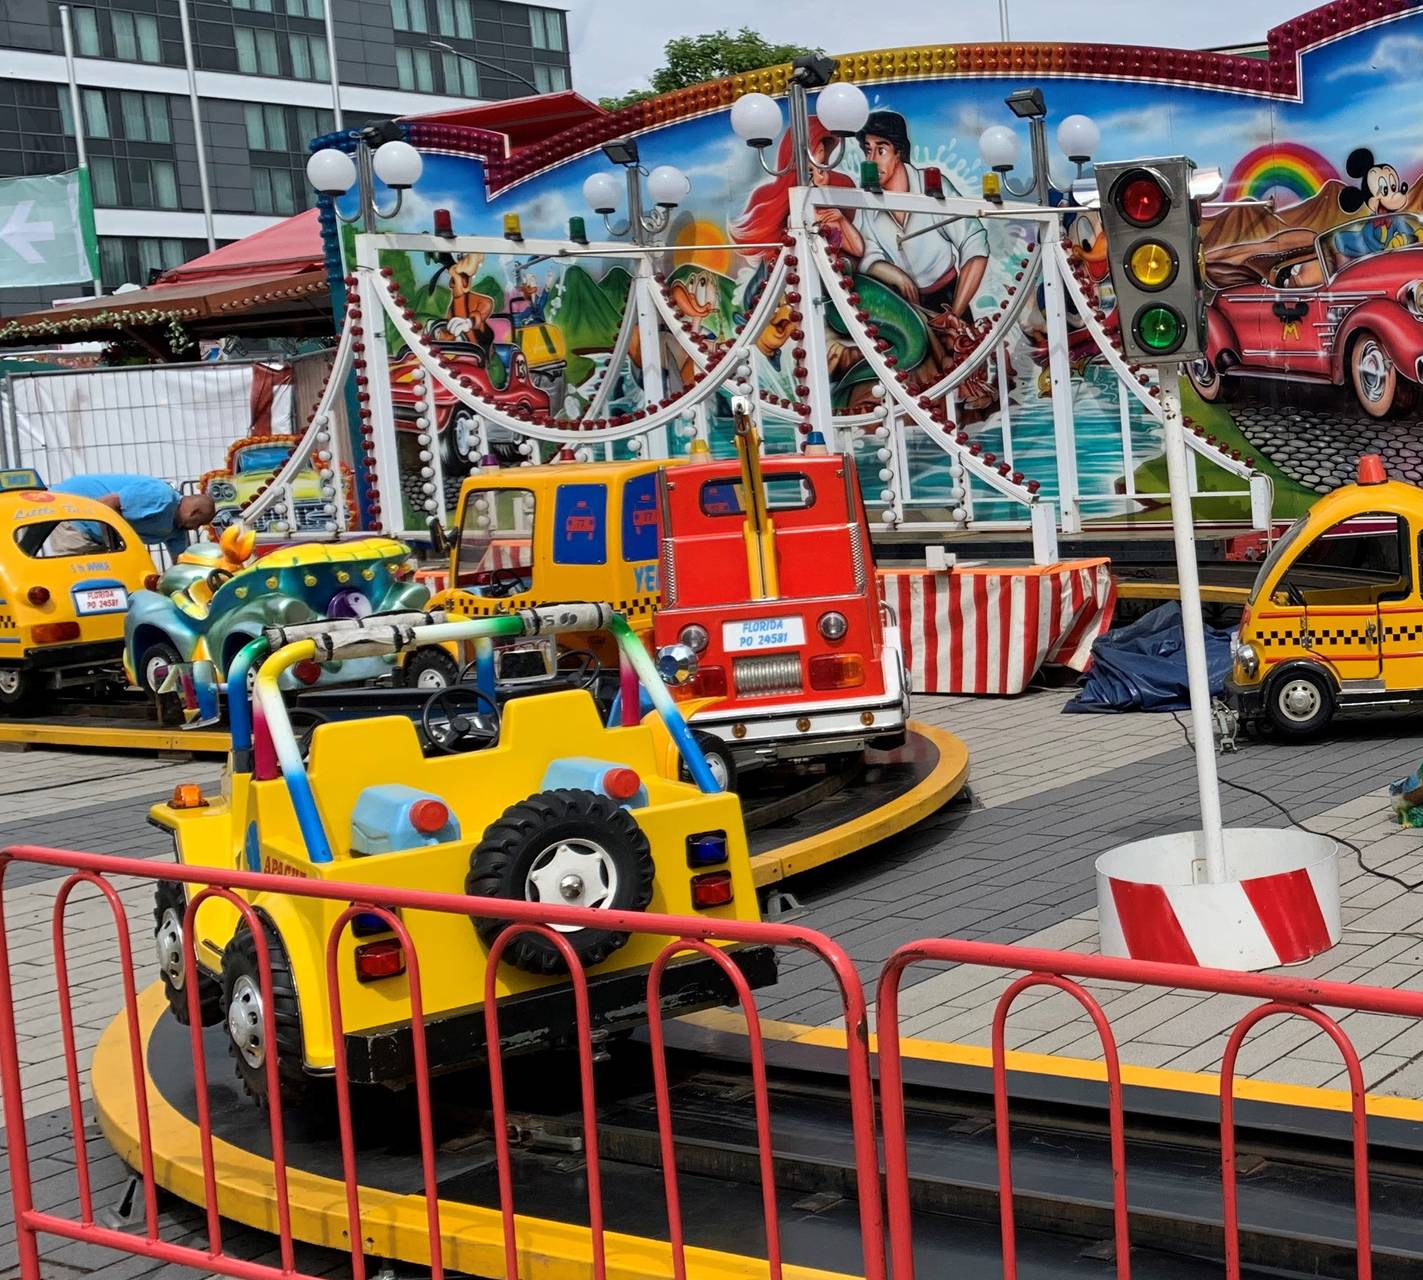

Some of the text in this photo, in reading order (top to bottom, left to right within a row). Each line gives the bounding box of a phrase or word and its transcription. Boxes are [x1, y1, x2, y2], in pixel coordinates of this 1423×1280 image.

[742, 619, 784, 633] FLORIDA
[740, 632, 788, 648] PO 24581
